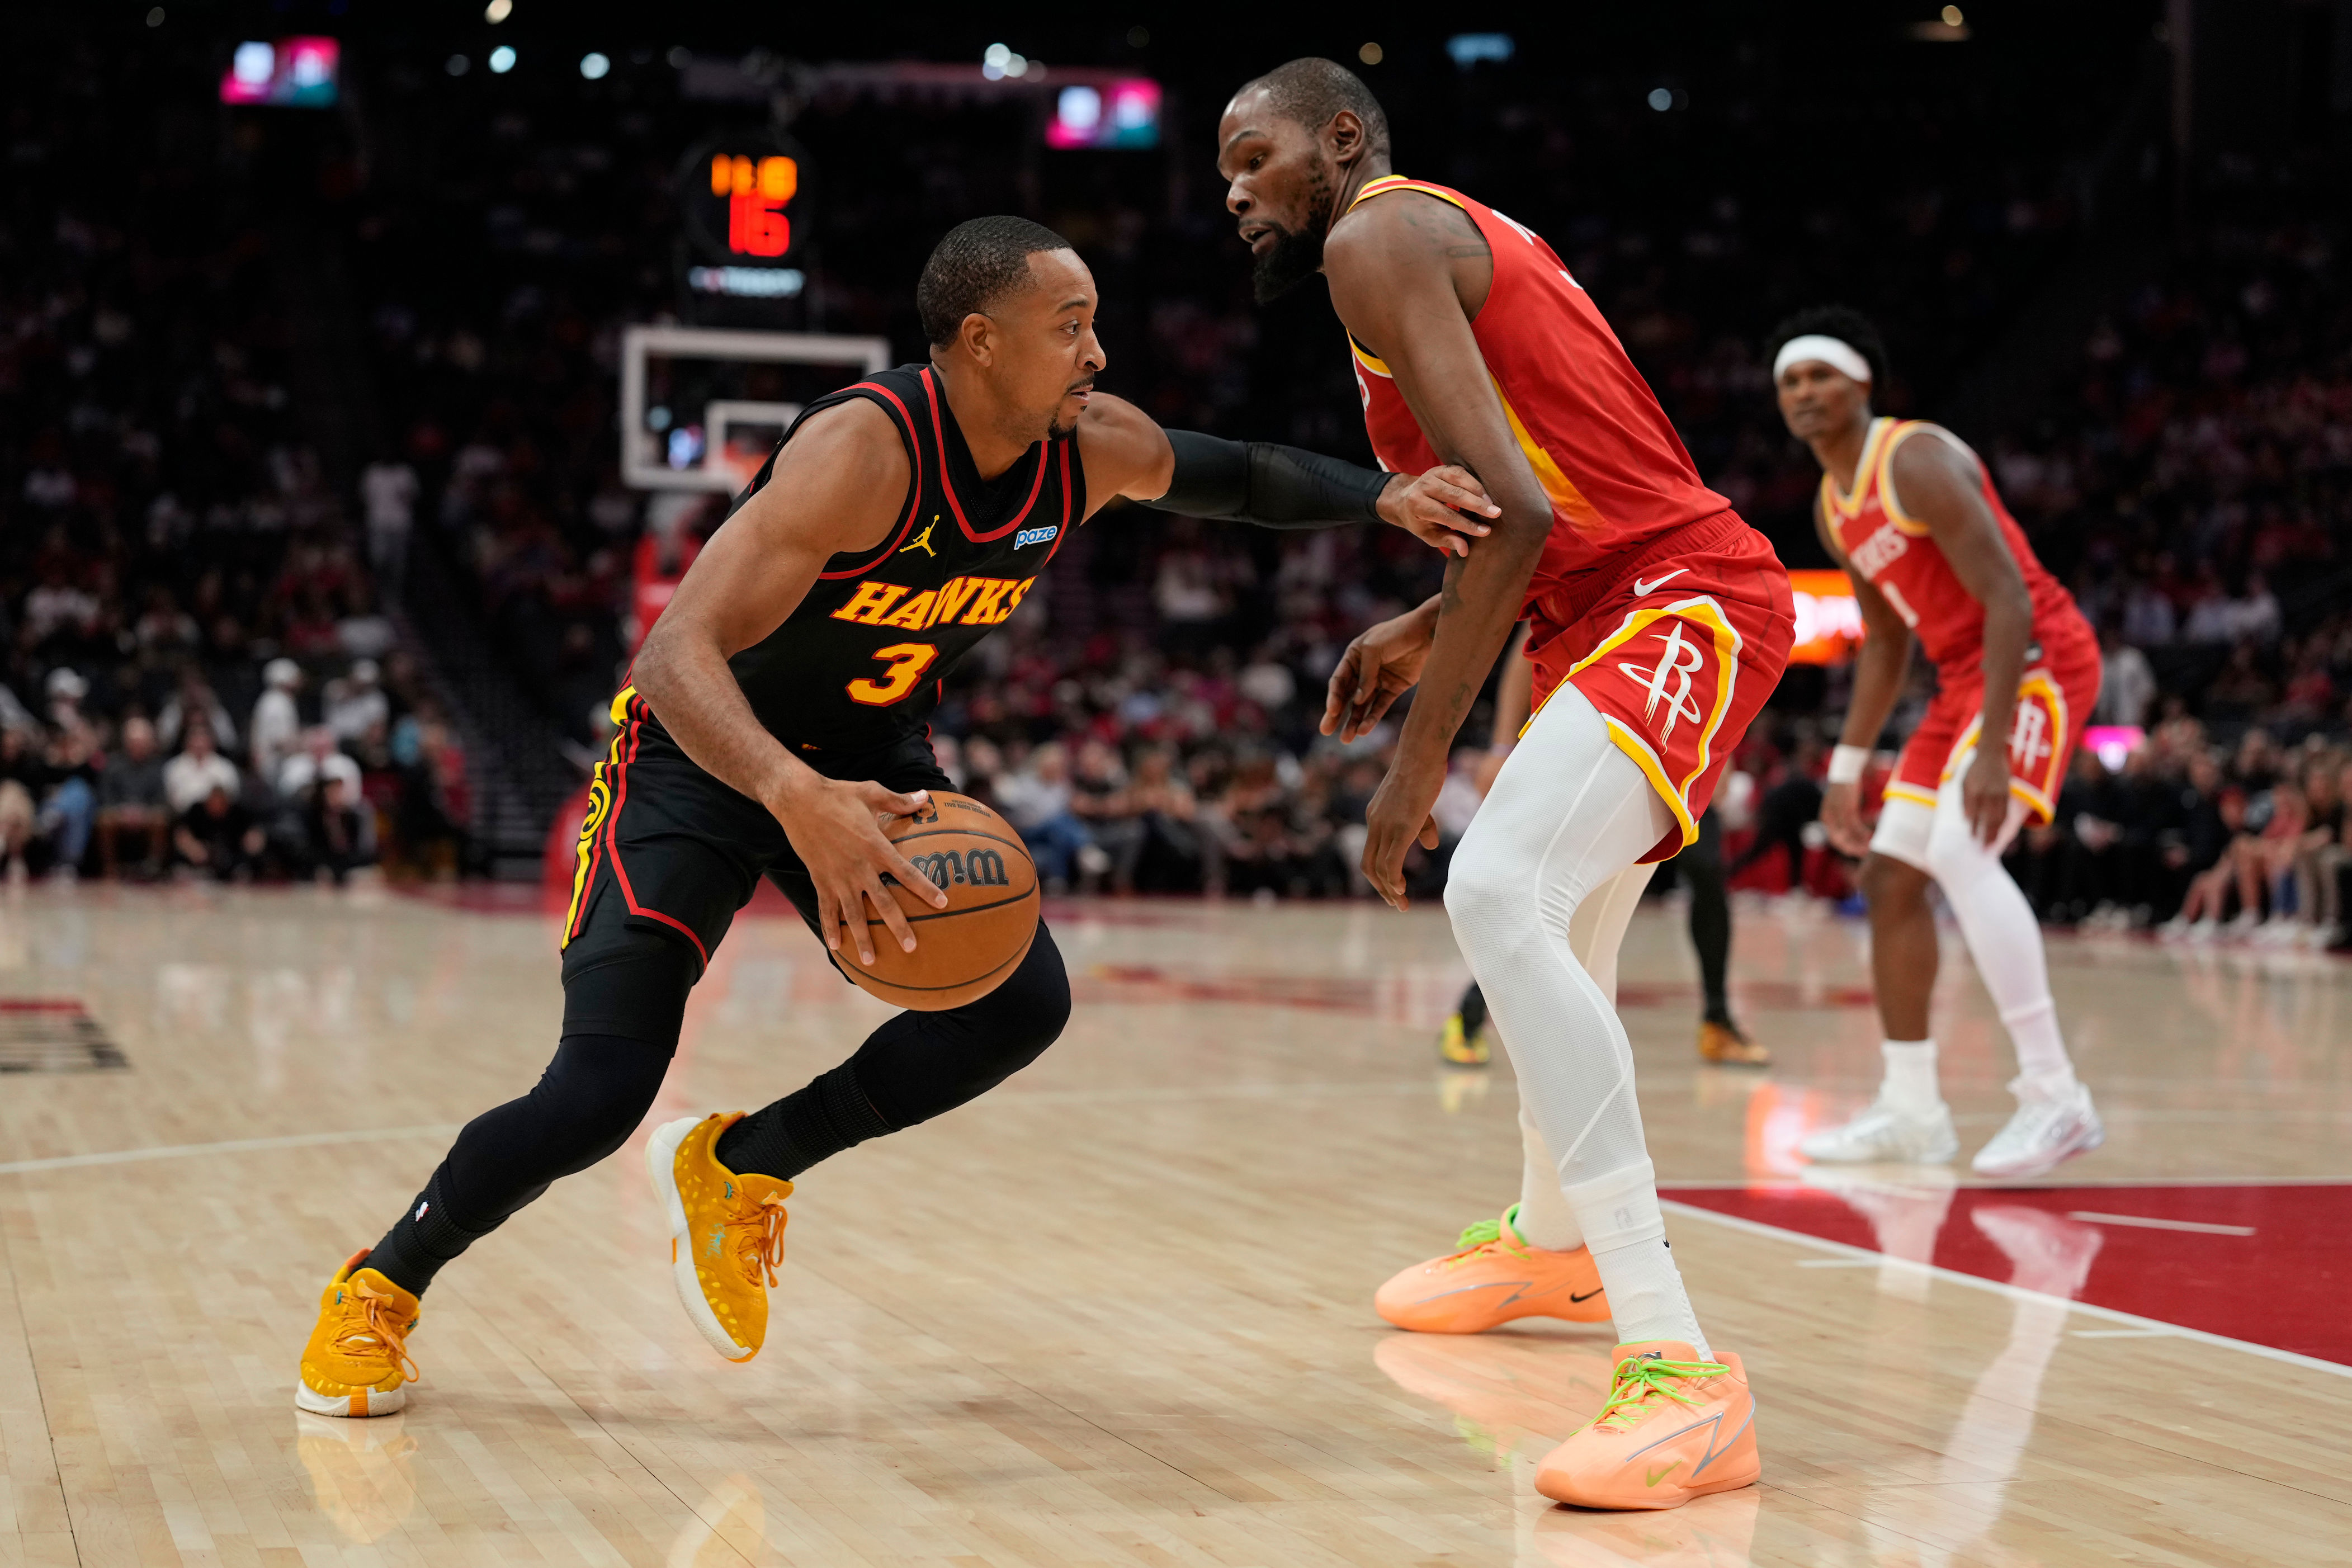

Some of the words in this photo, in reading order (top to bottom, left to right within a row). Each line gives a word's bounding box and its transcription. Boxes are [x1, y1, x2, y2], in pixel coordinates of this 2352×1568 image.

[1016, 527, 1056, 549] paze
[829, 575, 1038, 631] HAWKS
[845, 642, 939, 707] 3
